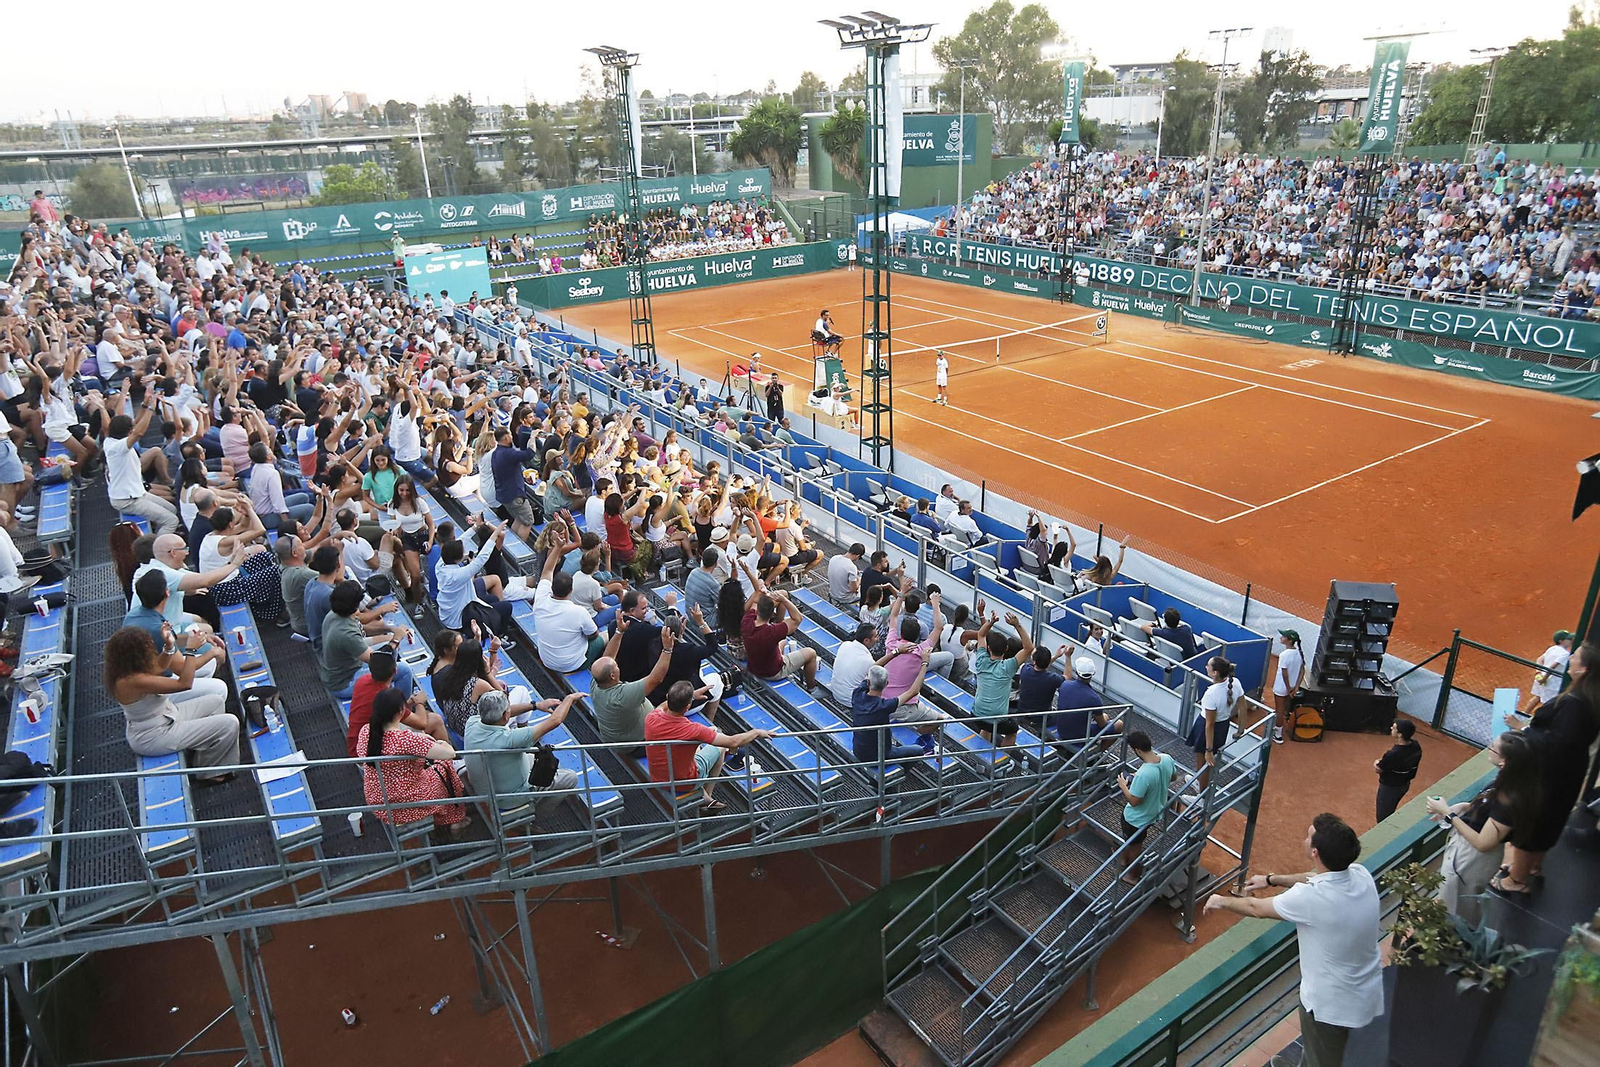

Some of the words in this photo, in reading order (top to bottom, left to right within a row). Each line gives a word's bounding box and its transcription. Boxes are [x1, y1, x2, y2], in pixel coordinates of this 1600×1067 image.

[1380, 59, 1401, 121] HUELVA
[1062, 77, 1076, 132] Huelva
[642, 187, 672, 195] Ayuntamiento
[690, 181, 726, 195] Huelva
[642, 192, 681, 205] HUELVA
[644, 265, 687, 278] yuntamiento
[686, 264, 695, 272] de
[704, 257, 753, 276] Huelva
[647, 273, 698, 291] HUELVA
[568, 285, 604, 298] Seabery
[966, 245, 1012, 266] TENIS
[1089, 263, 1135, 285] 1889
[1250, 285, 1300, 311] DEL
[1313, 294, 1399, 325] TENIS
[1409, 308, 1586, 353] ESPAÑOL
[1101, 298, 1130, 311] HUELVA
[1134, 298, 1164, 313] Huelva
[1522, 369, 1556, 382] Barceló
